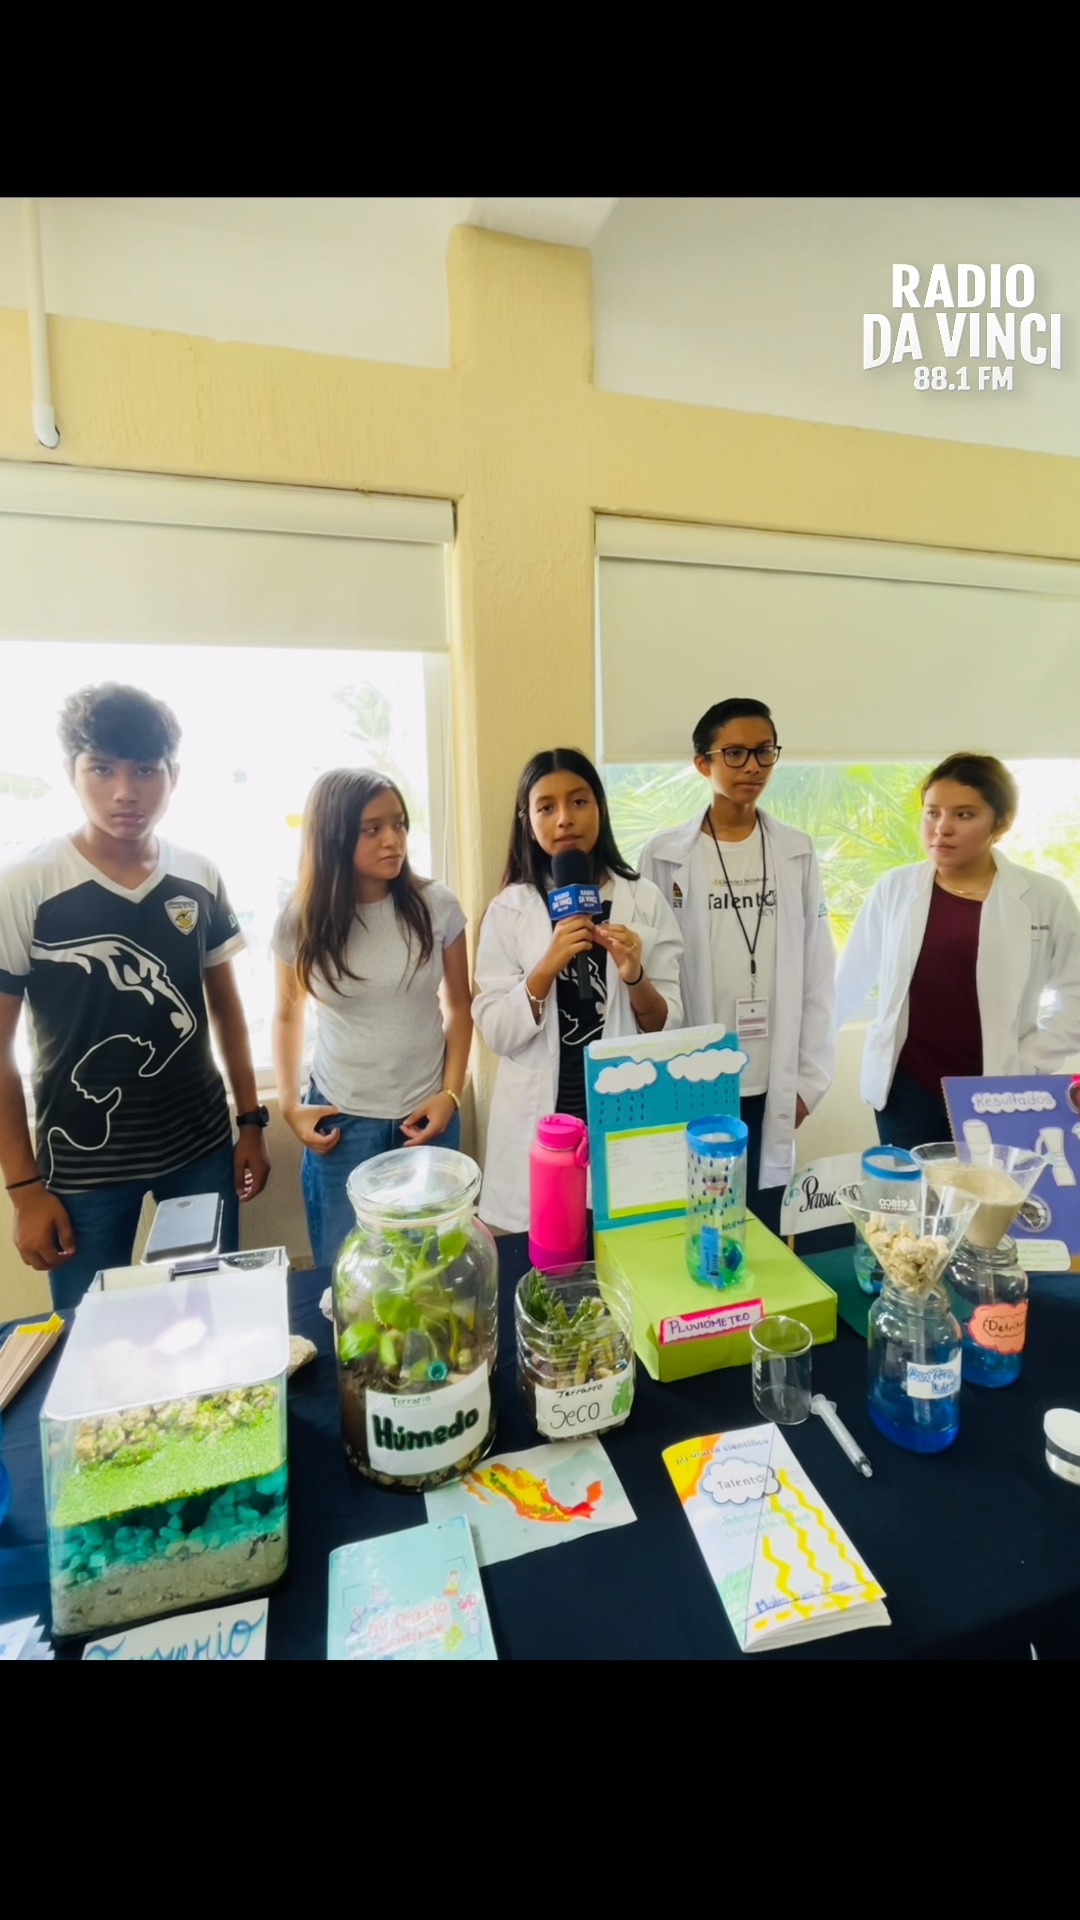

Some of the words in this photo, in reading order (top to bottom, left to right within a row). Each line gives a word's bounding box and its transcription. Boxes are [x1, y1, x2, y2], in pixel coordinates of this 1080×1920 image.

[975, 1093, 1054, 1108] Resultados
[667, 1312, 751, 1335] PLUVIÓMETRO
[557, 1384, 603, 1399] Terrario
[390, 1395, 432, 1408] Terrario
[371, 1408, 480, 1452] Húmedo
